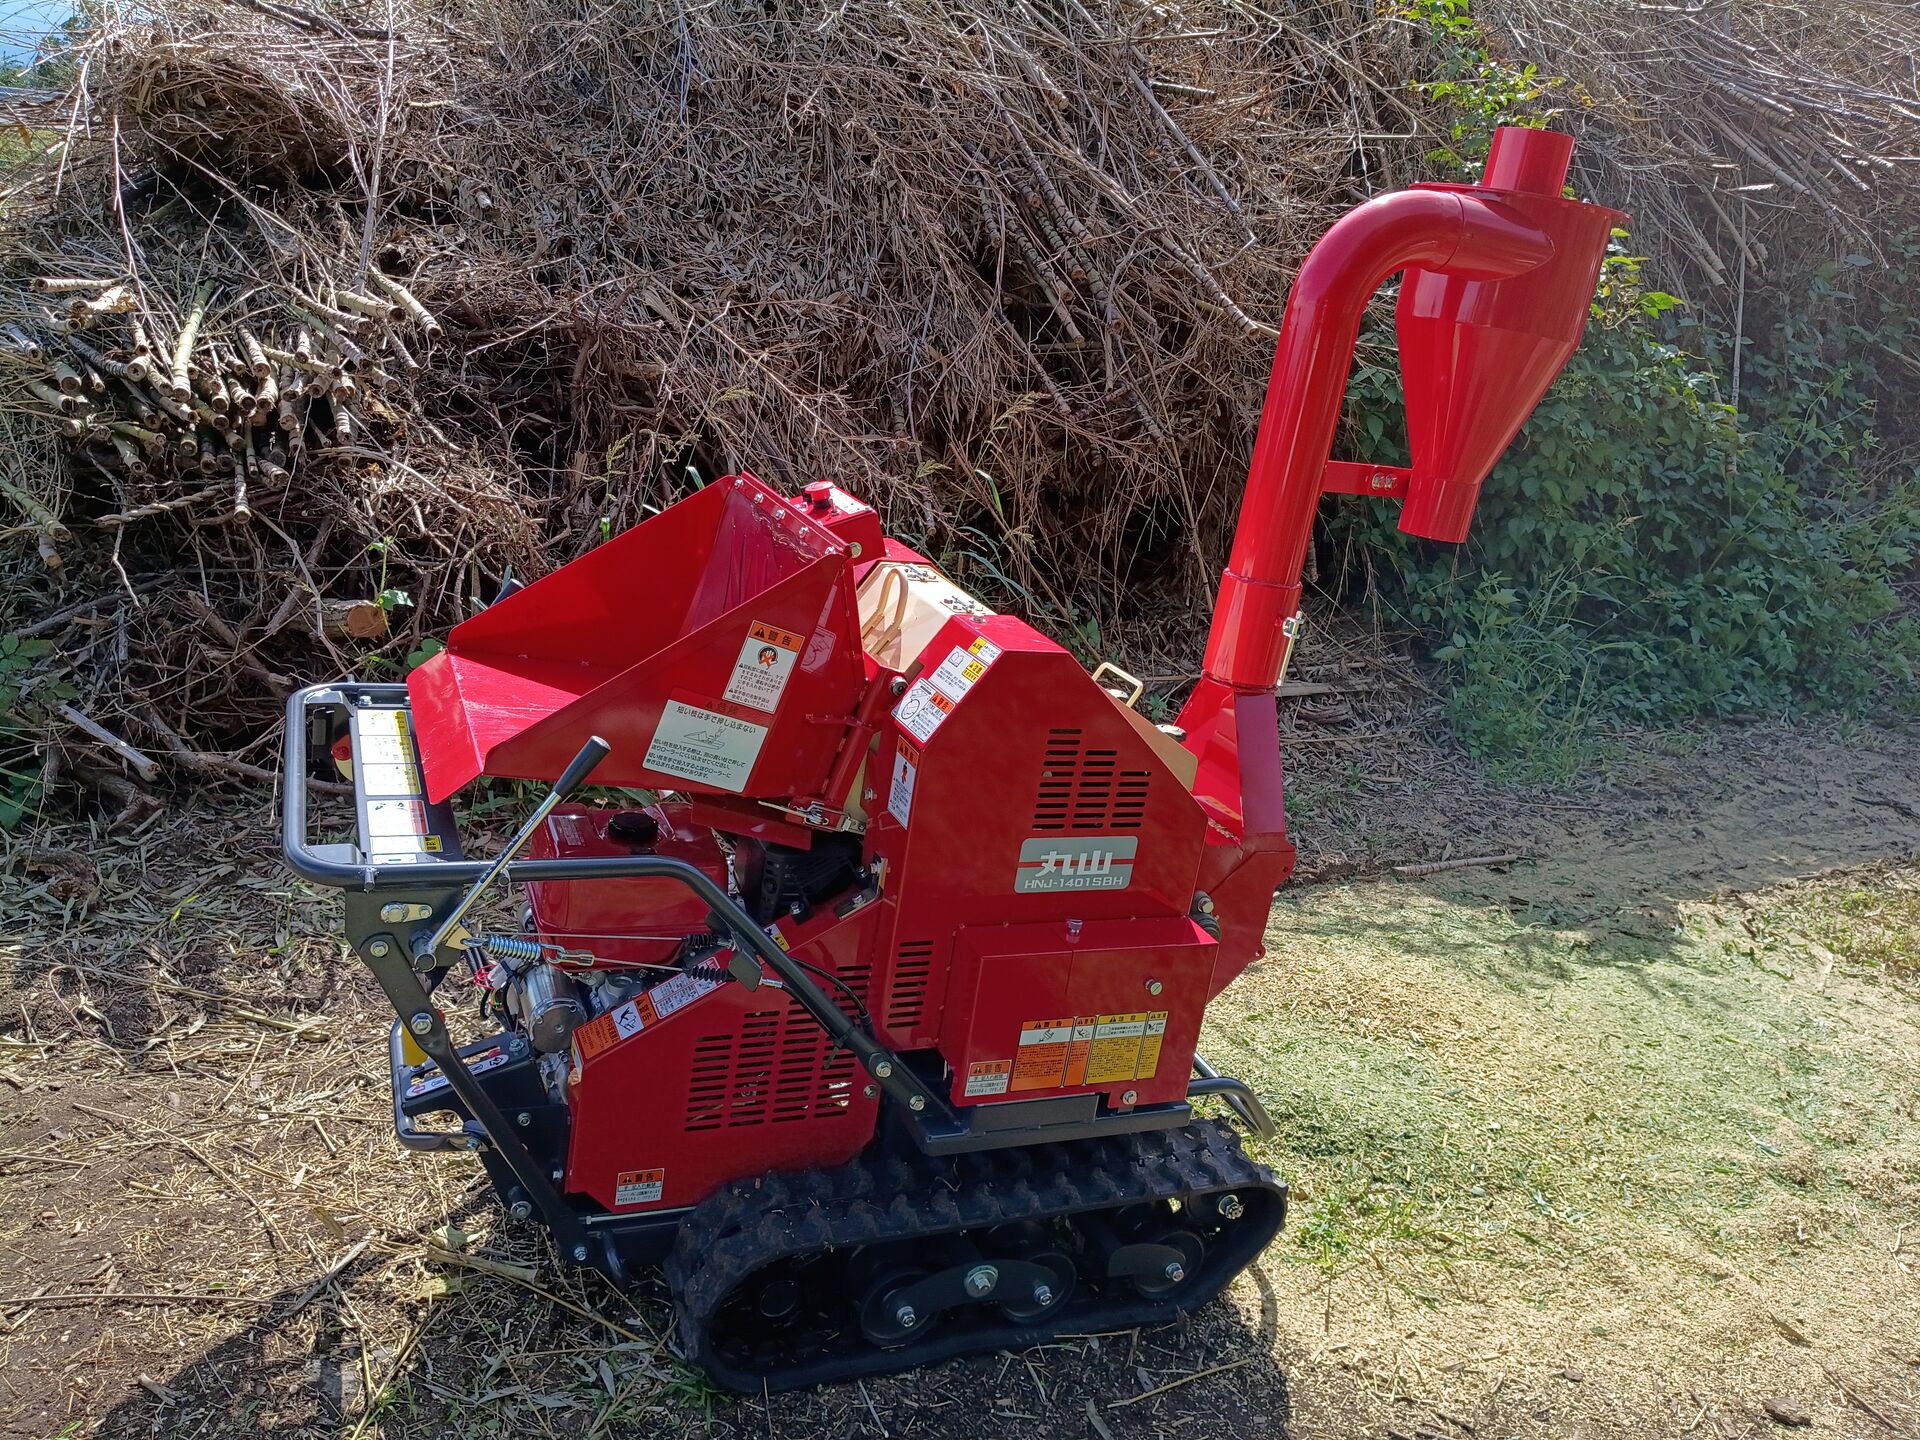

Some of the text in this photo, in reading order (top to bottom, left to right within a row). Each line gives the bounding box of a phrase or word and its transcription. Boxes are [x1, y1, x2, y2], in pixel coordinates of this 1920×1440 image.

[768, 630, 792, 646] 警告
[676, 705, 756, 734] 短い枝は手で押し込まない
[1035, 850, 1113, 877] 丸山
[1024, 876, 1123, 889] HNJ-1401SBH
